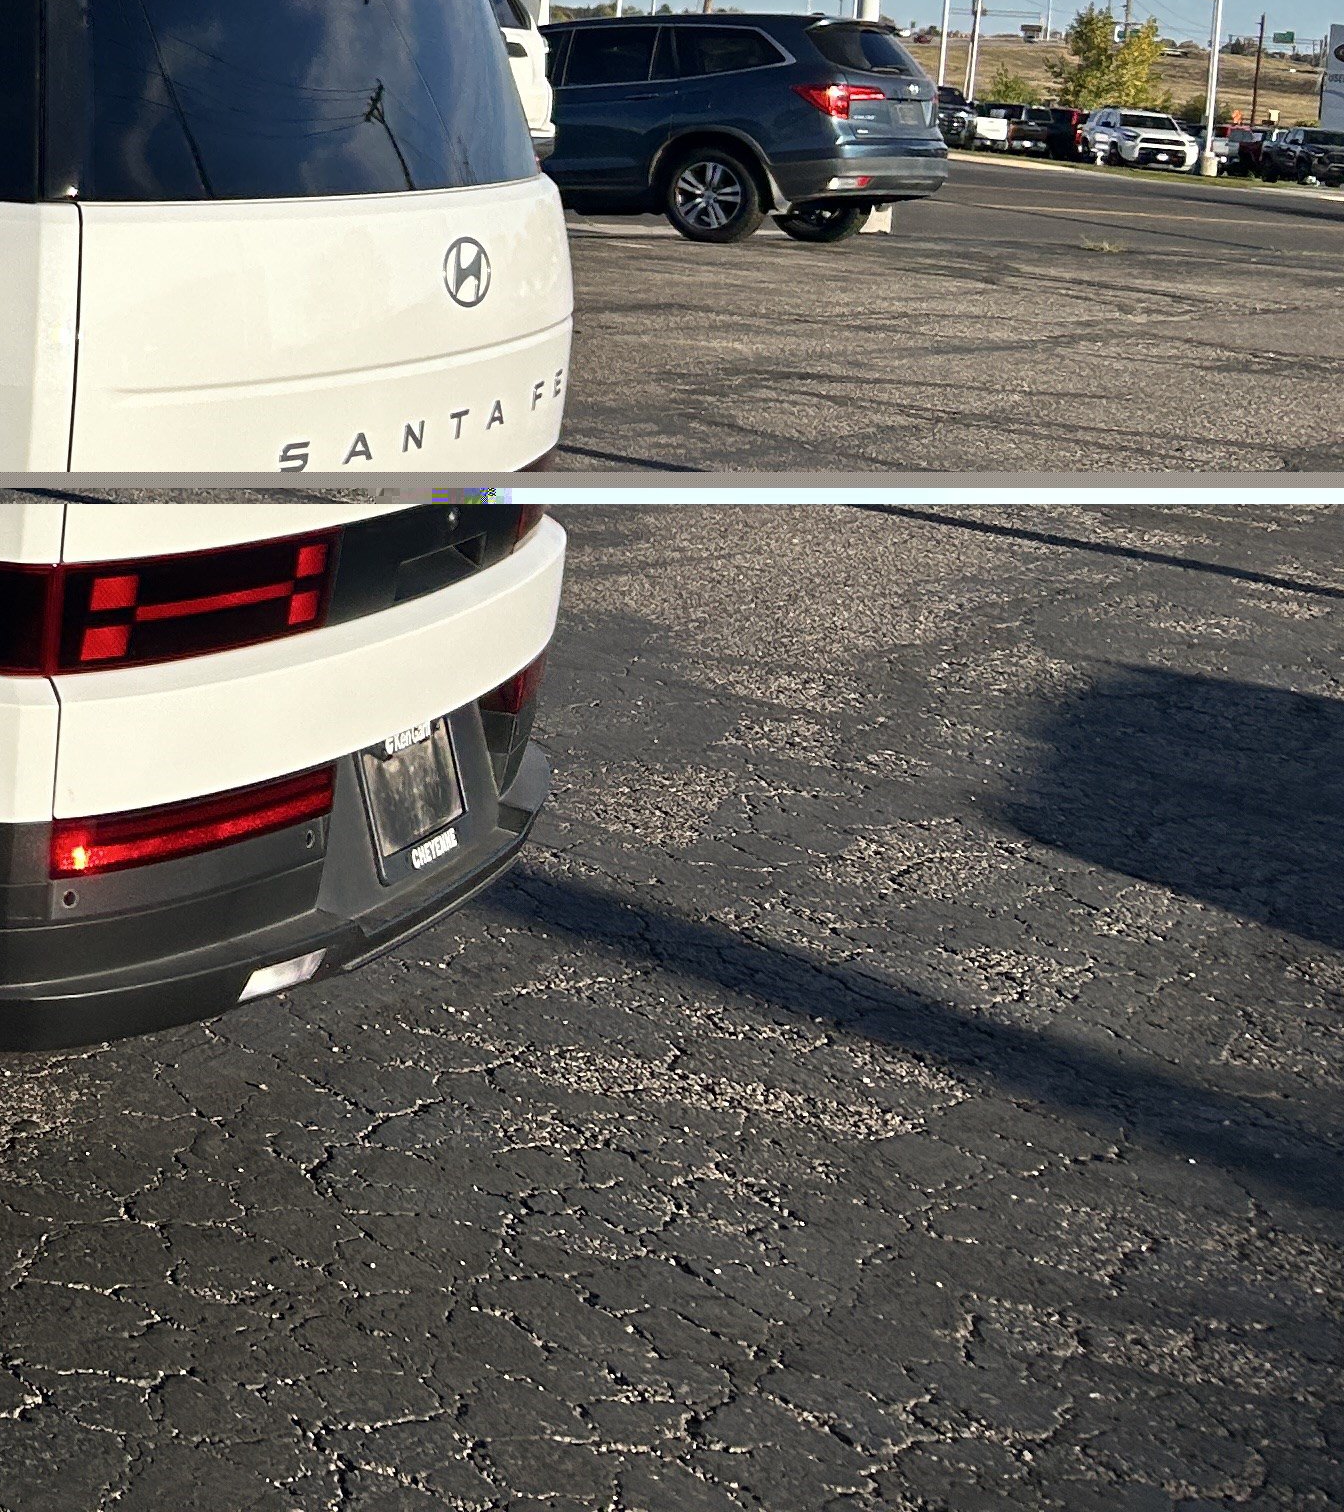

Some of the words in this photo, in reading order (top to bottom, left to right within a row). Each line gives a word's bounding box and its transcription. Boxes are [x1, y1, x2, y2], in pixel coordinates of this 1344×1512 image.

[278, 400, 505, 472] SANTA
[531, 369, 563, 411] FE
[411, 827, 458, 869] CHEYENNE
